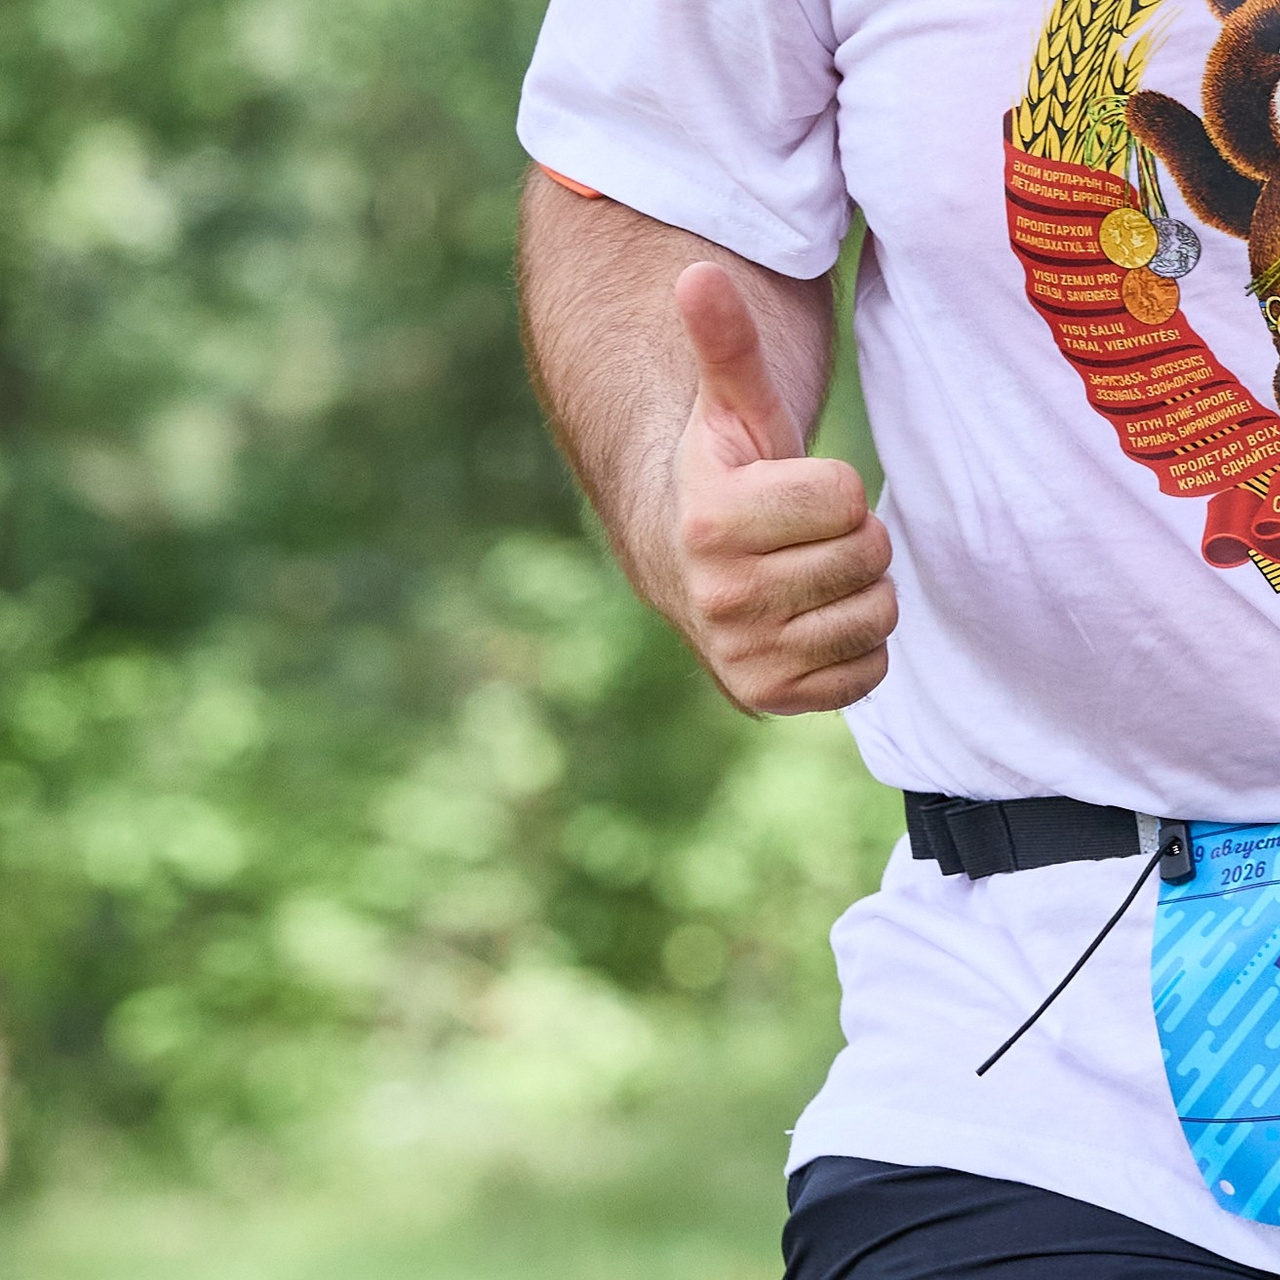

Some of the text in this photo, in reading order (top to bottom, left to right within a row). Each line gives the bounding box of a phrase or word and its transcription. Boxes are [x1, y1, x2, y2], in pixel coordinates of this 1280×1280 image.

[1032, 268, 1059, 284] VISU
[1096, 272, 1122, 285] PRO-
[1063, 337, 1103, 353] TARAI,
[1195, 389, 1239, 413] ПРОЛЕ-
[1221, 861, 1267, 886] 2026
